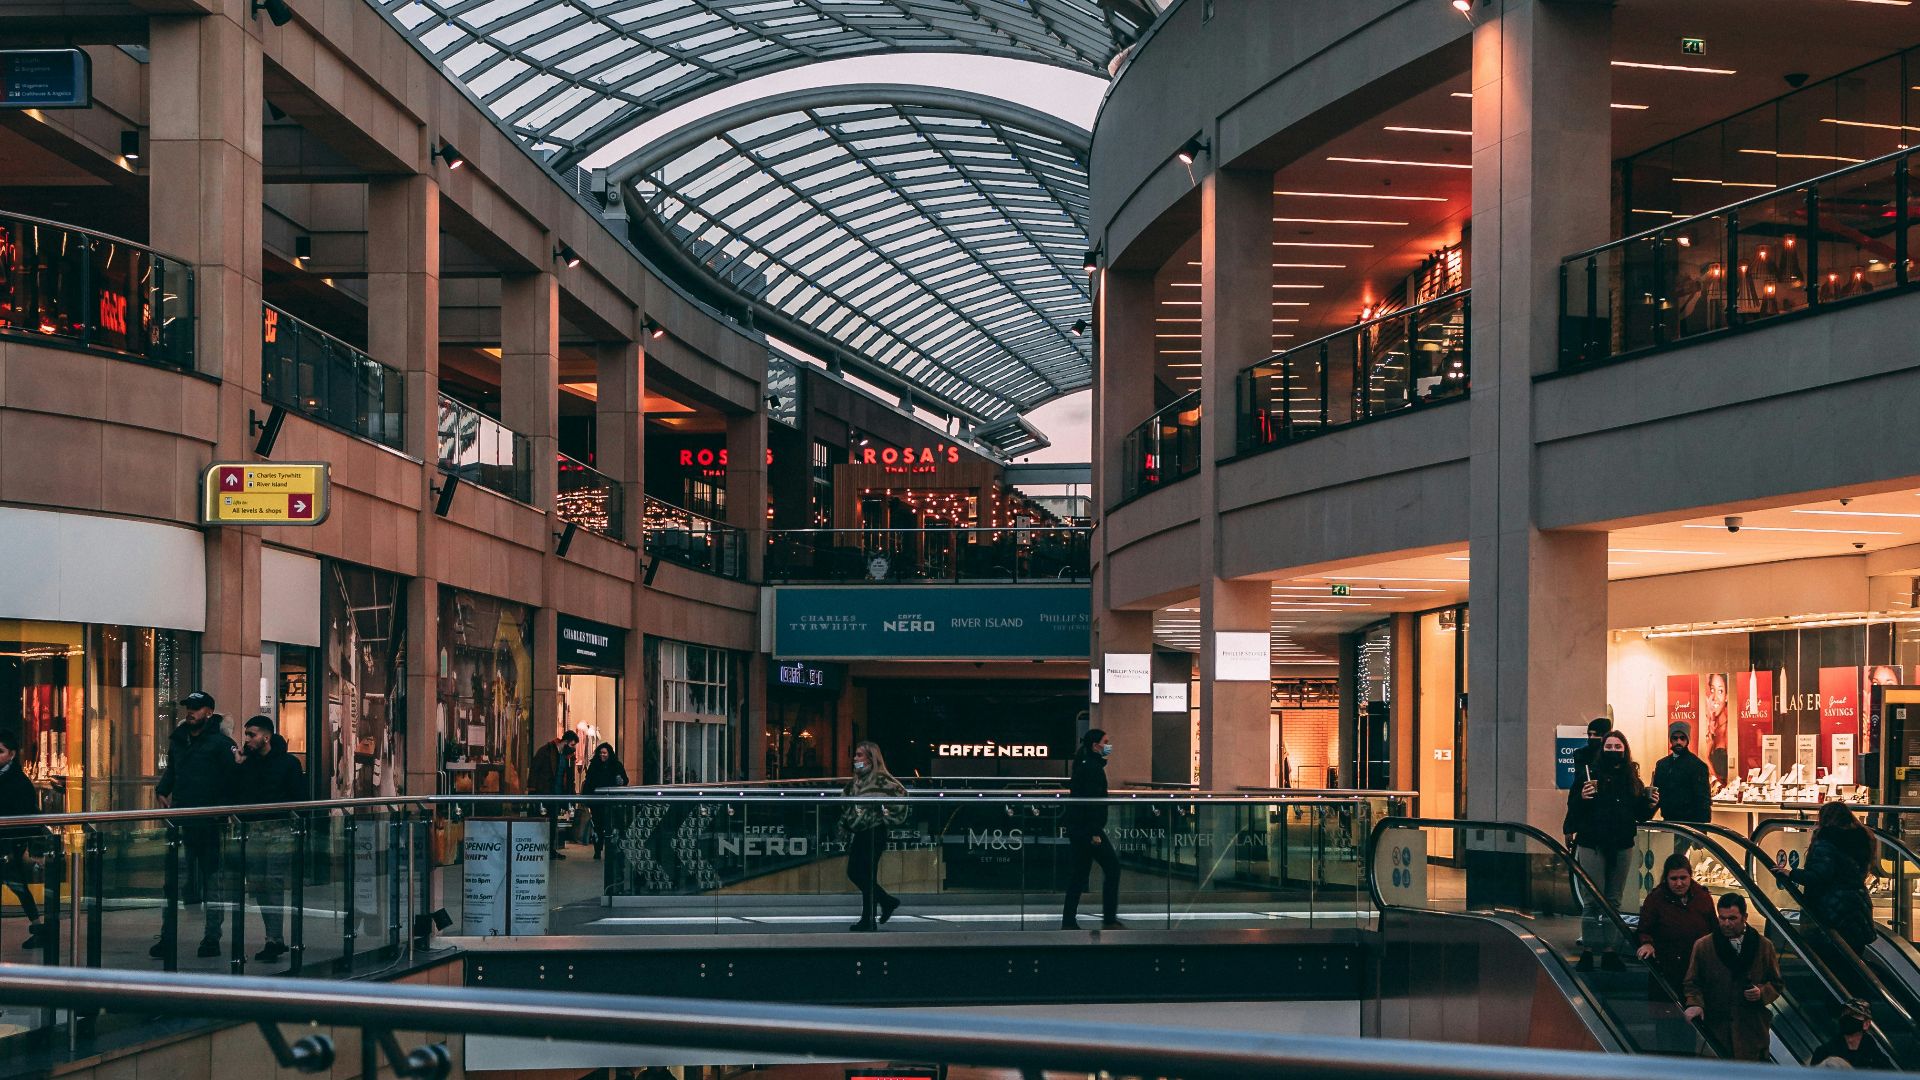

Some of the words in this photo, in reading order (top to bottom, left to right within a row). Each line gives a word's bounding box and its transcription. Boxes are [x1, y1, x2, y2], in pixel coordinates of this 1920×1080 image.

[864, 444, 959, 464] ROSA'S
[951, 618, 981, 628] RIVER
[985, 618, 1023, 628] ISLAND
[1040, 613, 1077, 622] PHILLIP
[883, 621, 935, 632] NERO
[1774, 694, 1821, 711] FASER
[1670, 711, 1696, 719] SAVINGS
[1824, 708, 1853, 716] SAVINGS
[939, 740, 995, 756] CAFFÈ
[998, 745, 1048, 757] NERO
[1114, 826, 1165, 839] STONER
[968, 828, 1022, 850] M&S
[1174, 833, 1214, 846] RIVER
[718, 837, 808, 856] NERO
[821, 841, 937, 852] TYHITT
[515, 852, 544, 862] hours
